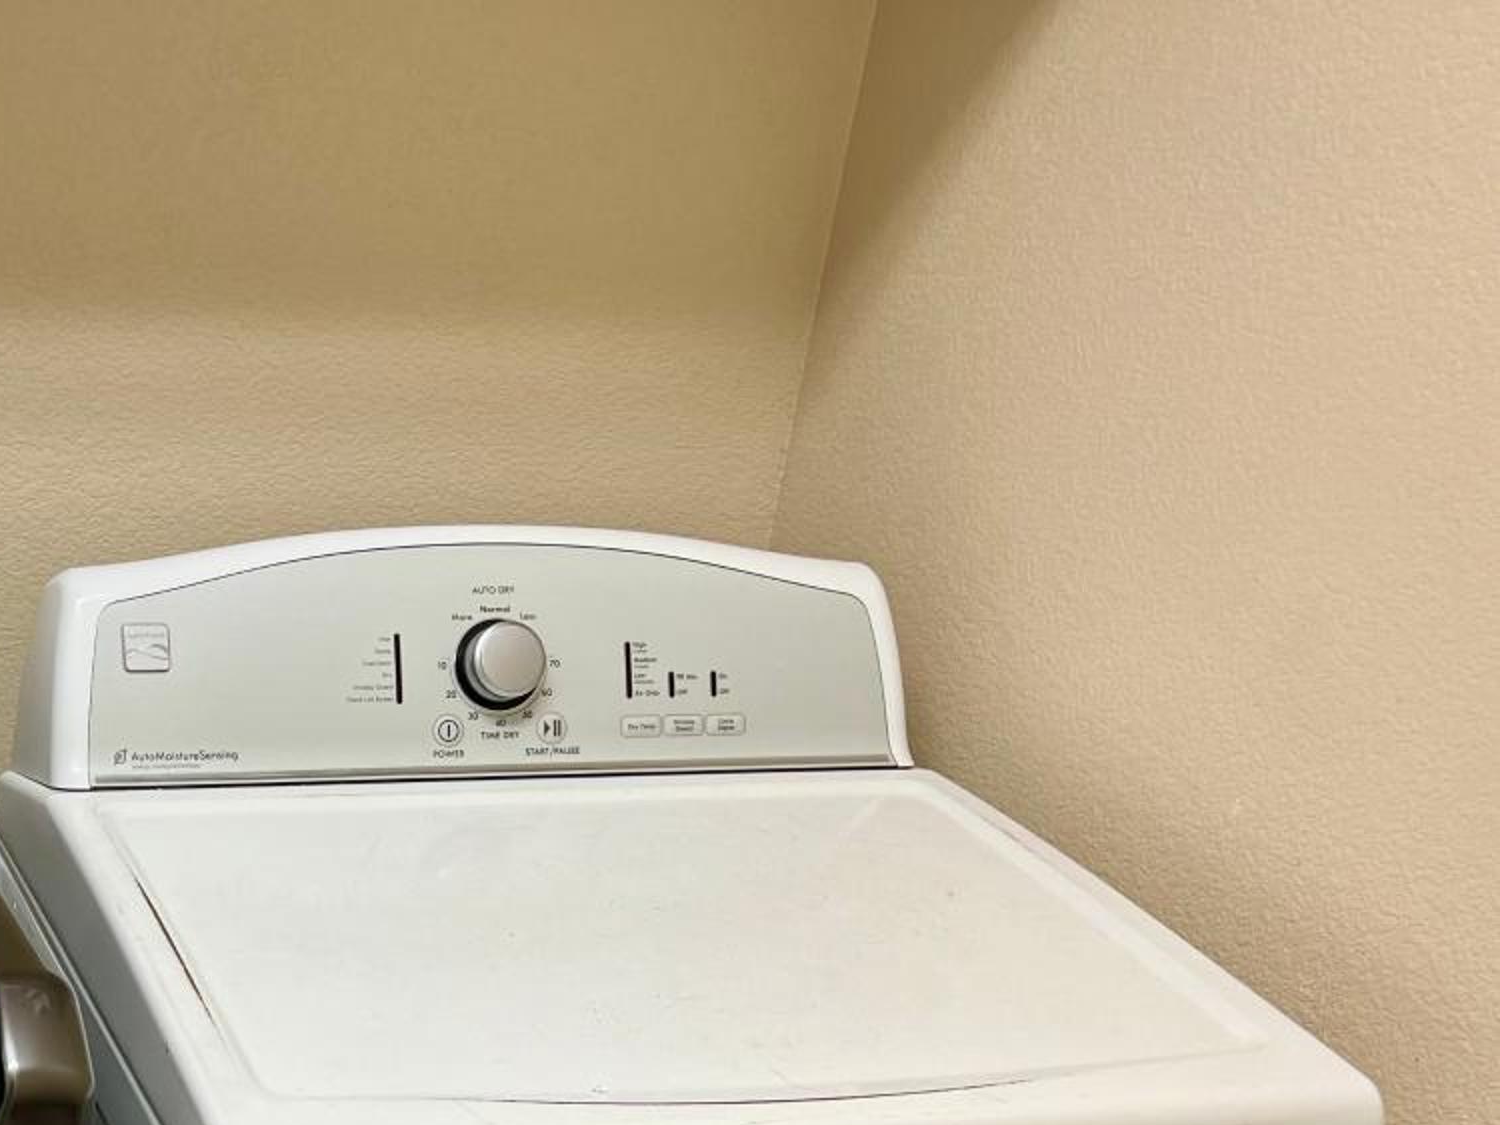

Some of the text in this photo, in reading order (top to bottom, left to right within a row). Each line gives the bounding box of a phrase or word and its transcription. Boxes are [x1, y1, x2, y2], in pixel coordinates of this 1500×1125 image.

[472, 585, 514, 595] AUTO DRY
[480, 605, 511, 613] Normal
[438, 661, 447, 670] 10
[550, 659, 561, 668] 70
[468, 711, 479, 721] 30
[480, 731, 519, 740] TIME DRY
[432, 750, 465, 759] POWER
